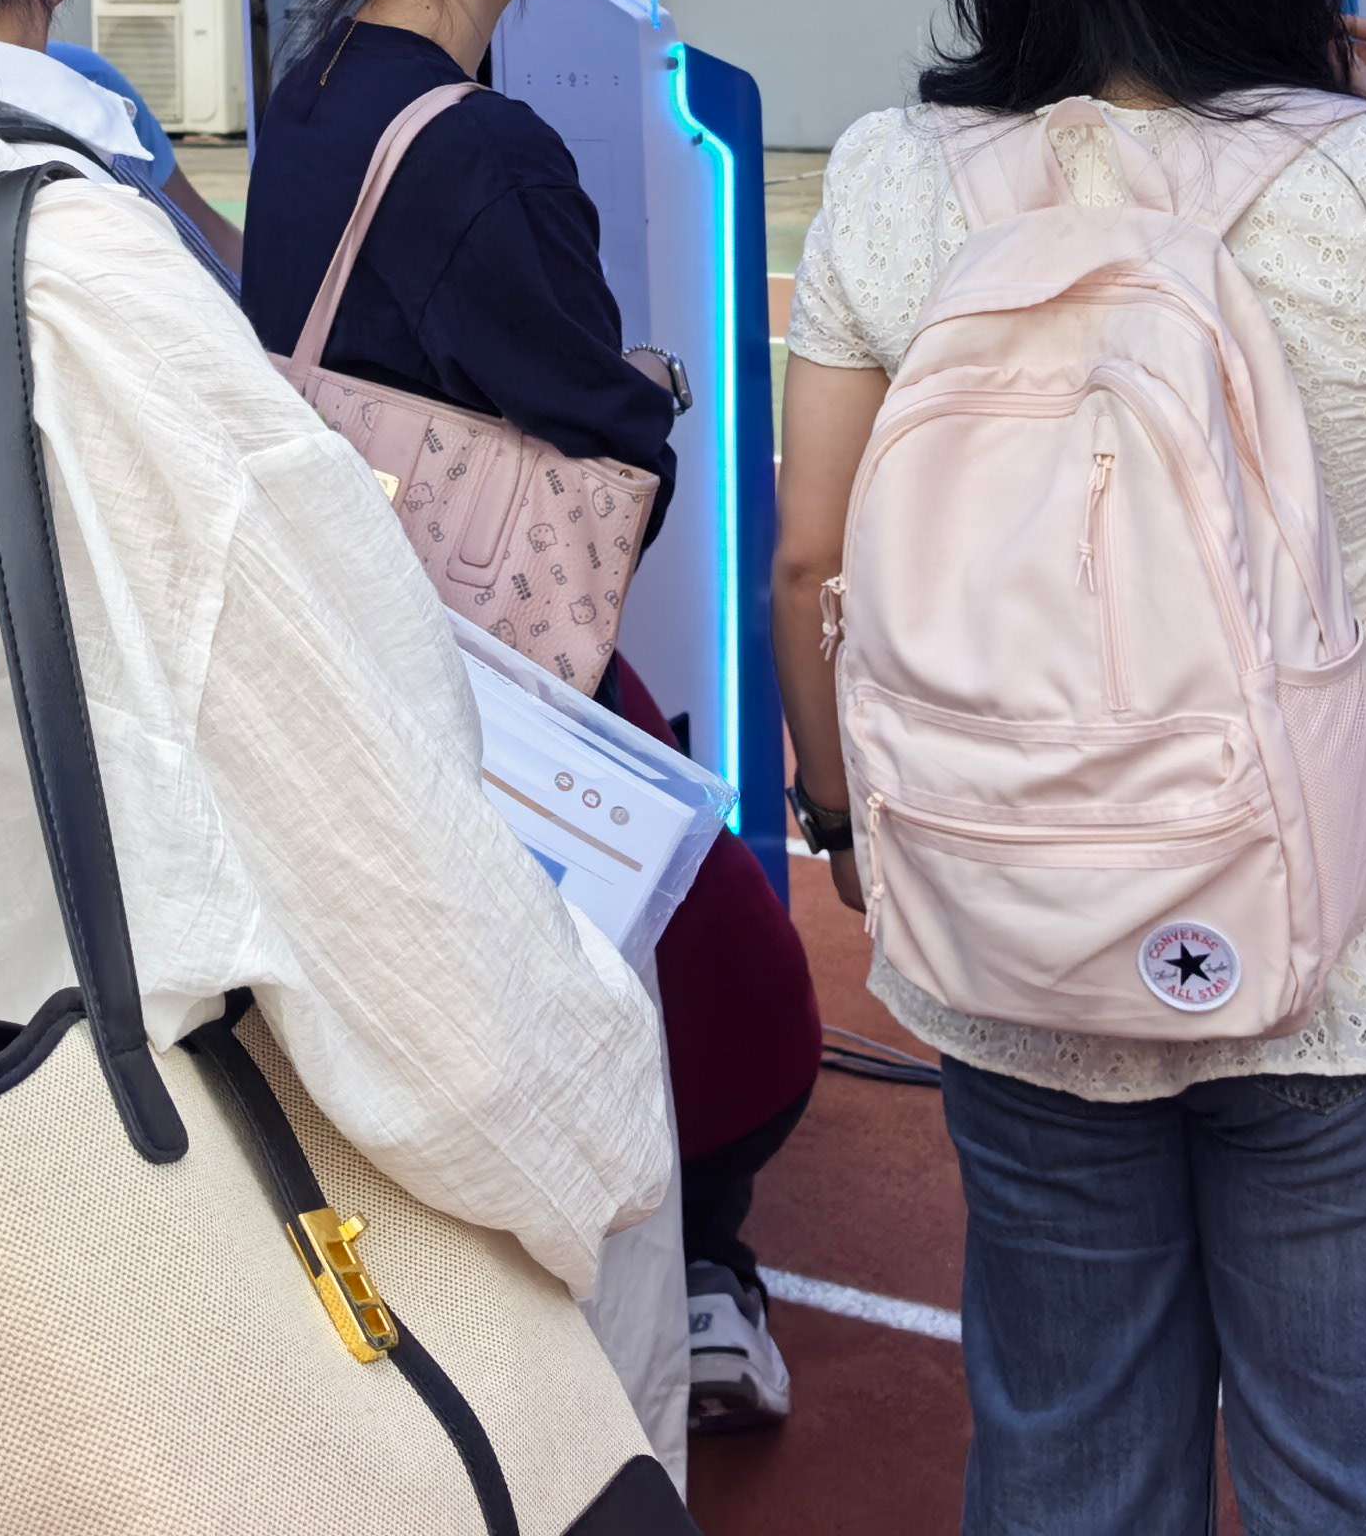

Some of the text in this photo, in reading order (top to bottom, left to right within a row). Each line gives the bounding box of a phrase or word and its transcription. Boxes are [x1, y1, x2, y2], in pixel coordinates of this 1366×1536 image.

[1148, 929, 1219, 960] CONVERSE
[1167, 977, 1228, 1001] ALL STAR
